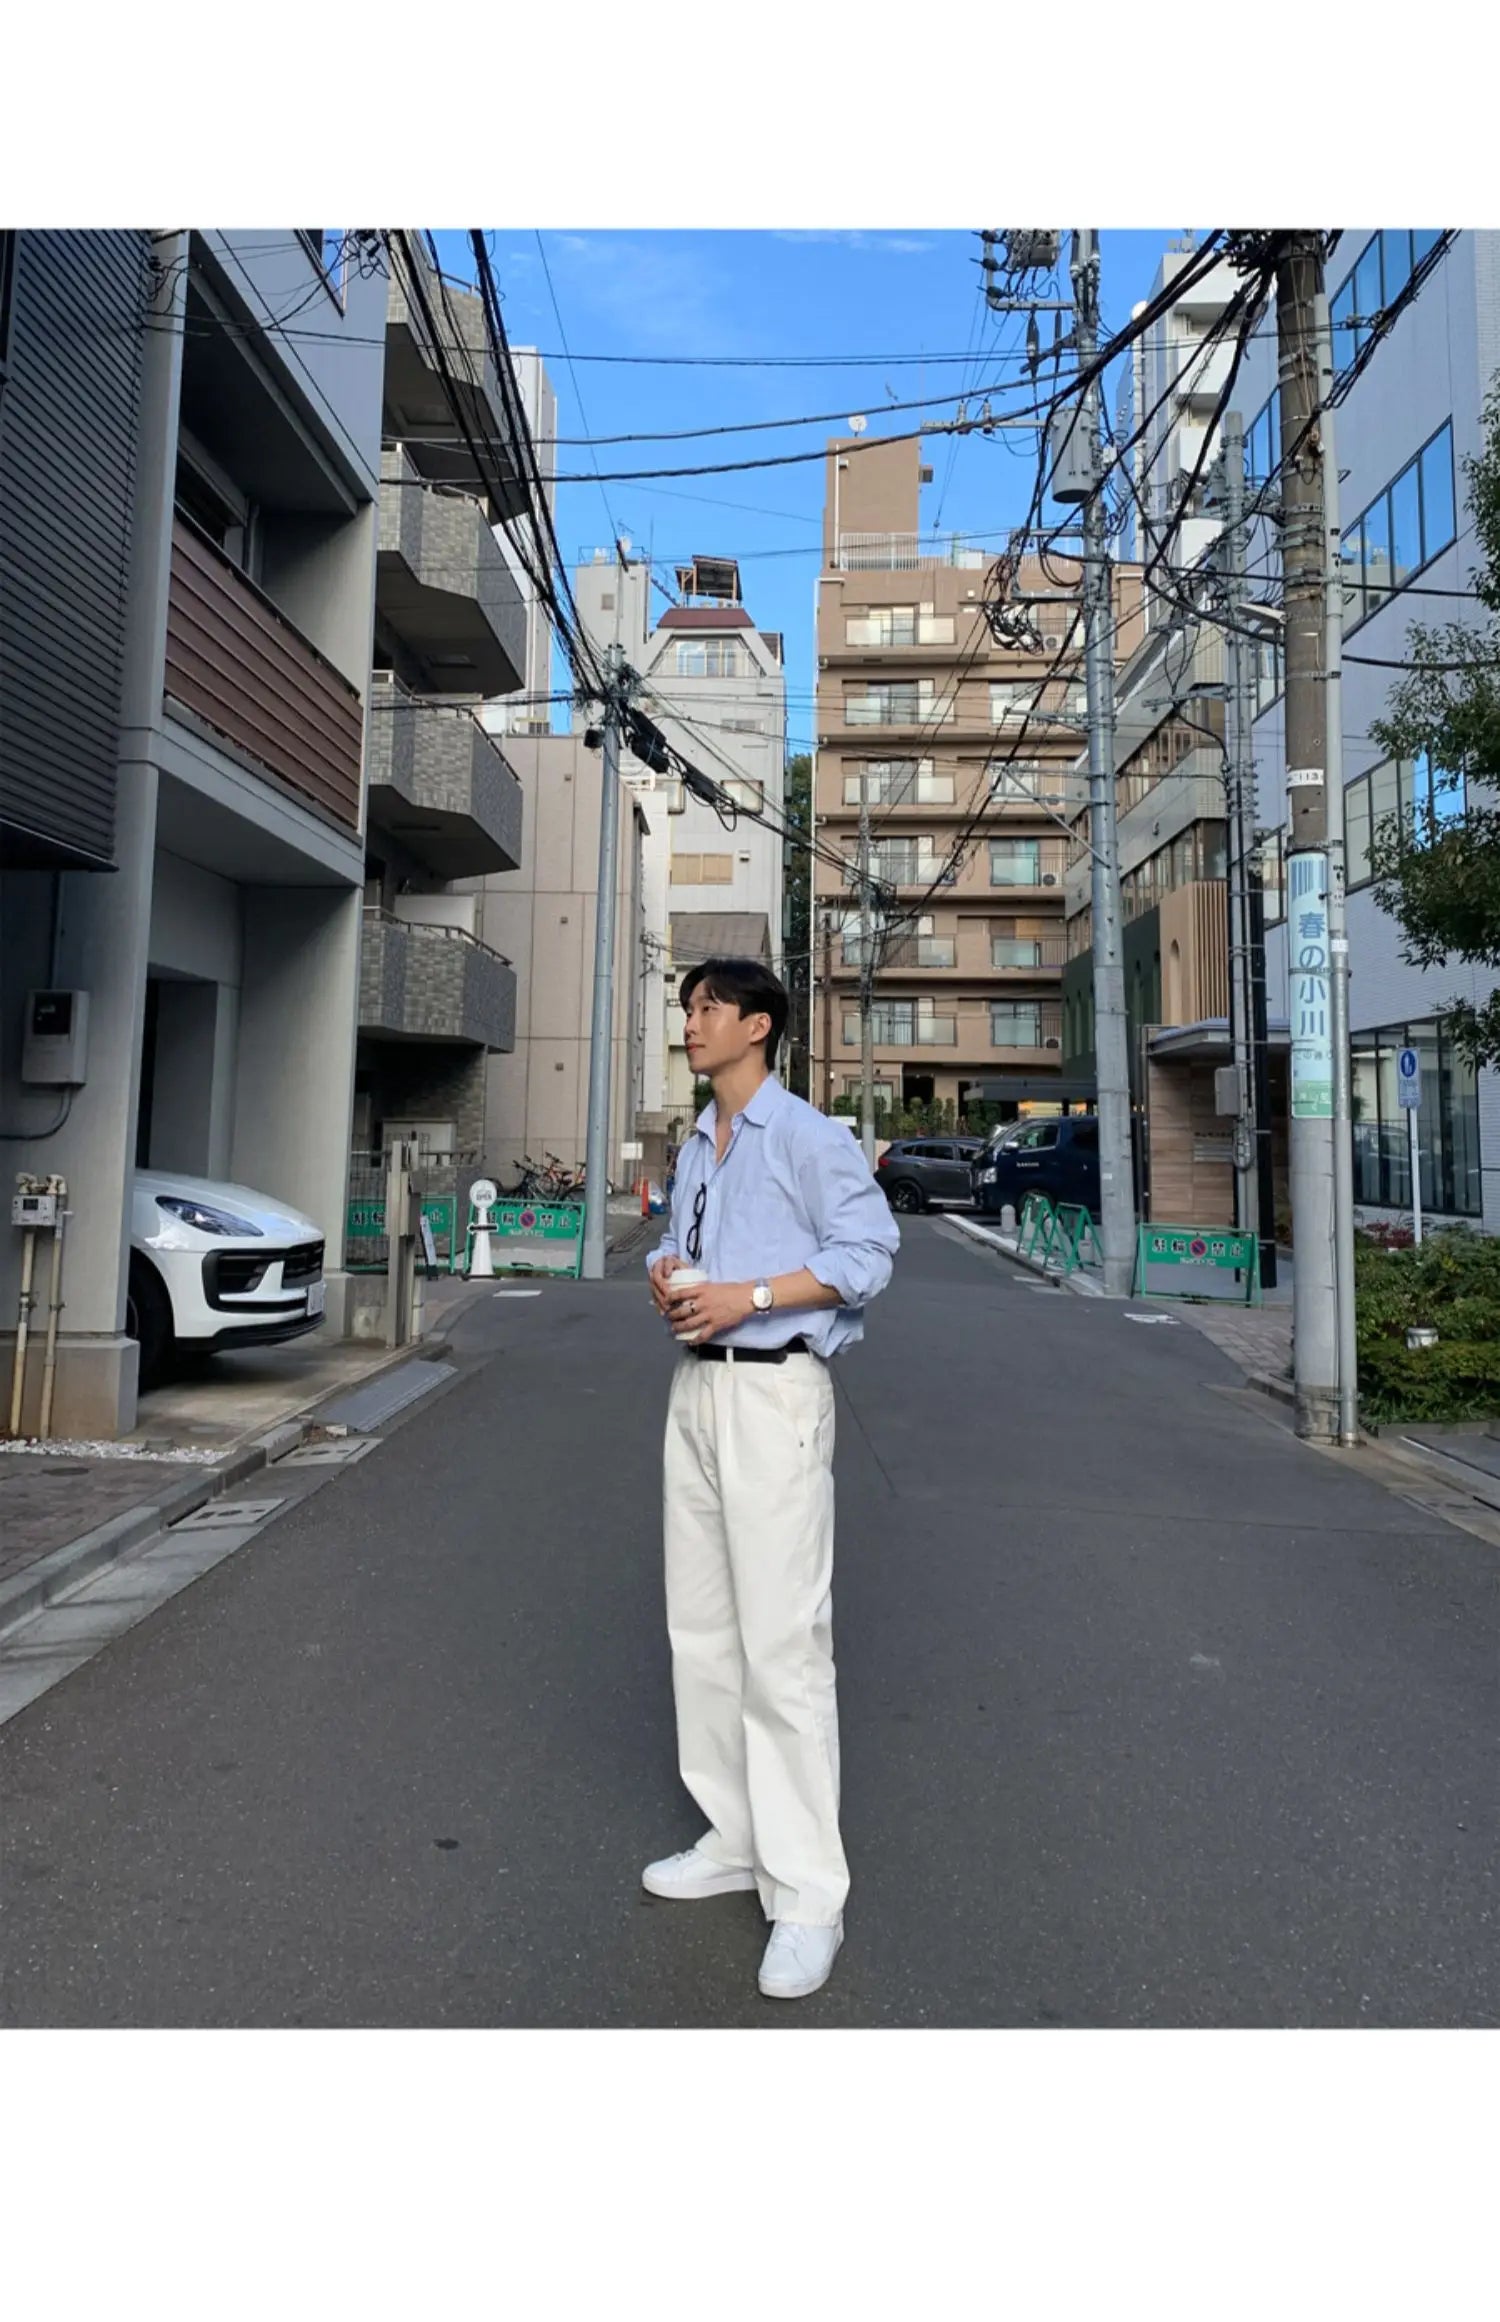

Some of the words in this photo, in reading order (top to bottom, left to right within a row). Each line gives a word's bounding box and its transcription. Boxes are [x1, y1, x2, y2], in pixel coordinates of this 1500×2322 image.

[1299, 911, 1326, 1036] 春の小川
[1152, 1237, 1187, 1255] 駐輪
[1211, 1241, 1244, 1258] 禁止
